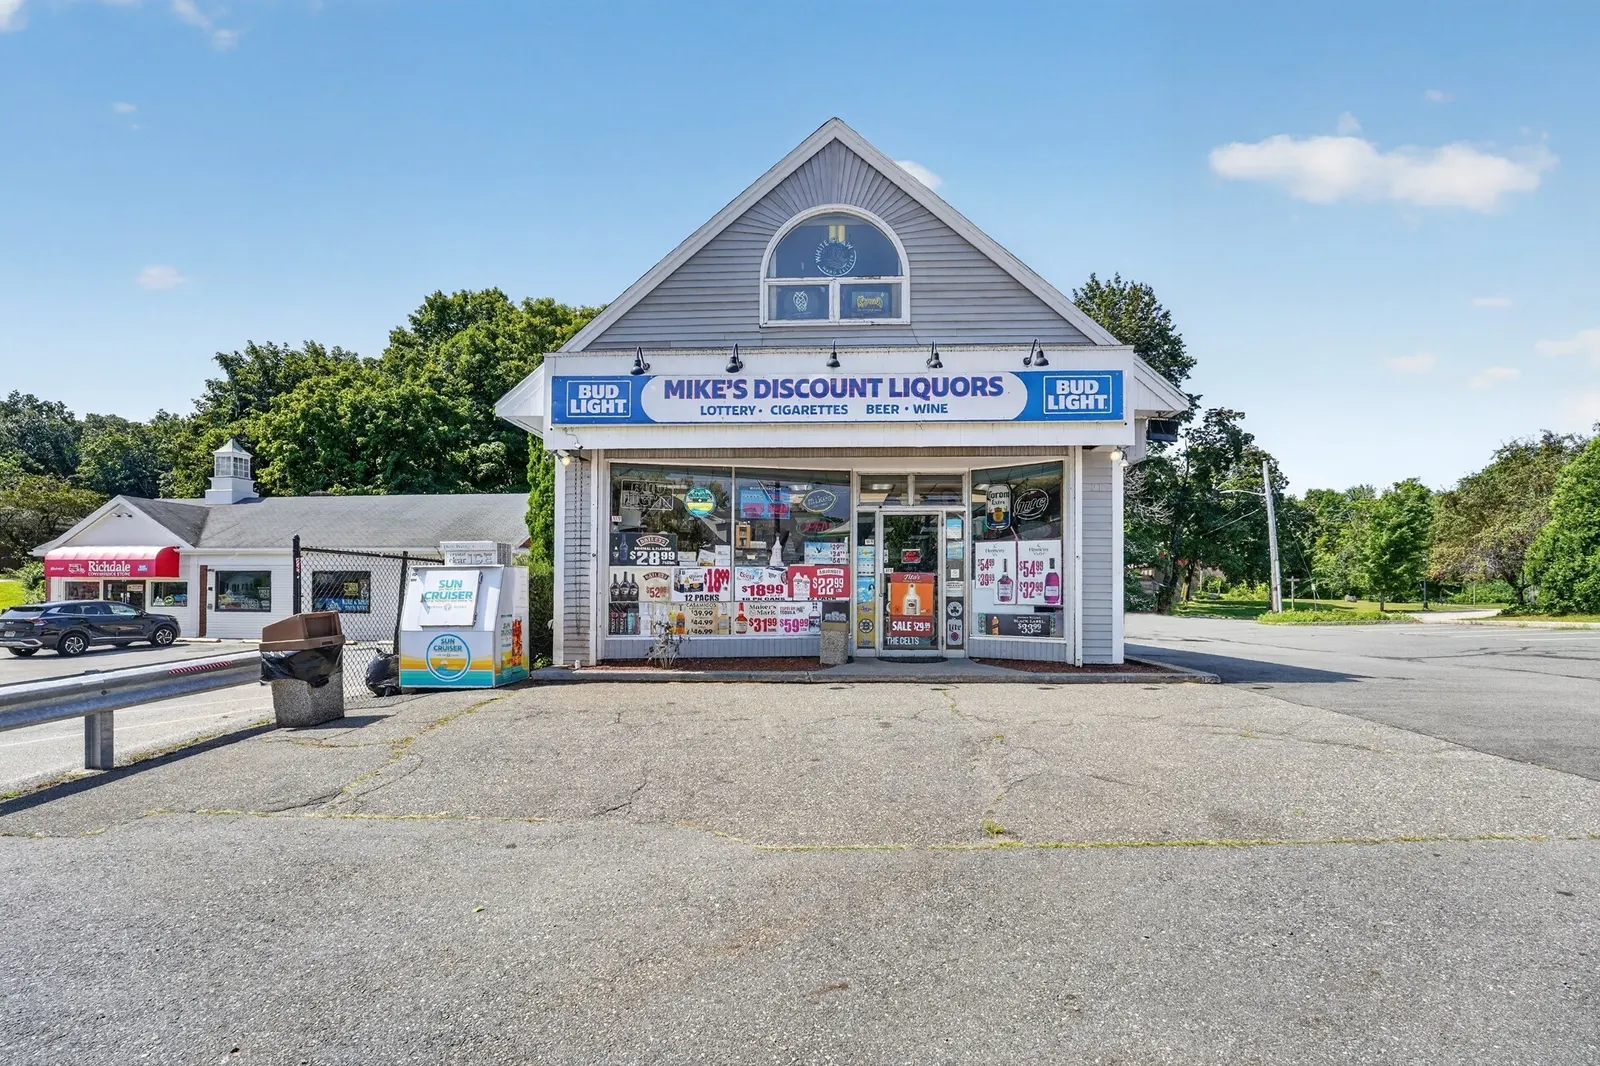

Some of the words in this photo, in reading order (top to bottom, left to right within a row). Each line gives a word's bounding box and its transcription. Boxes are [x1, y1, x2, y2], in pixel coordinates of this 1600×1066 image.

[815, 239, 829, 263] WHITE
[578, 384, 619, 399] BUD
[664, 378, 748, 400] MIKE'S
[753, 377, 883, 399] DISCOUNT
[889, 376, 1004, 401] LIQUORS
[1055, 379, 1099, 395] BUD
[570, 398, 627, 414] LIGHT
[1048, 394, 1107, 410] LIGHT
[700, 405, 756, 416] LOTTERY
[770, 404, 849, 415] CIGARETTES
[866, 404, 900, 415] BEER
[913, 403, 949, 414] WINE
[88, 560, 131, 572] Richdale
[438, 579, 463, 589] SUN
[424, 591, 474, 600] CRUISER
[684, 594, 693, 602] 12
[694, 594, 720, 602] PACKS
[892, 621, 912, 631] SALE
[885, 636, 899, 645] THE
[899, 636, 920, 645] CELTS
